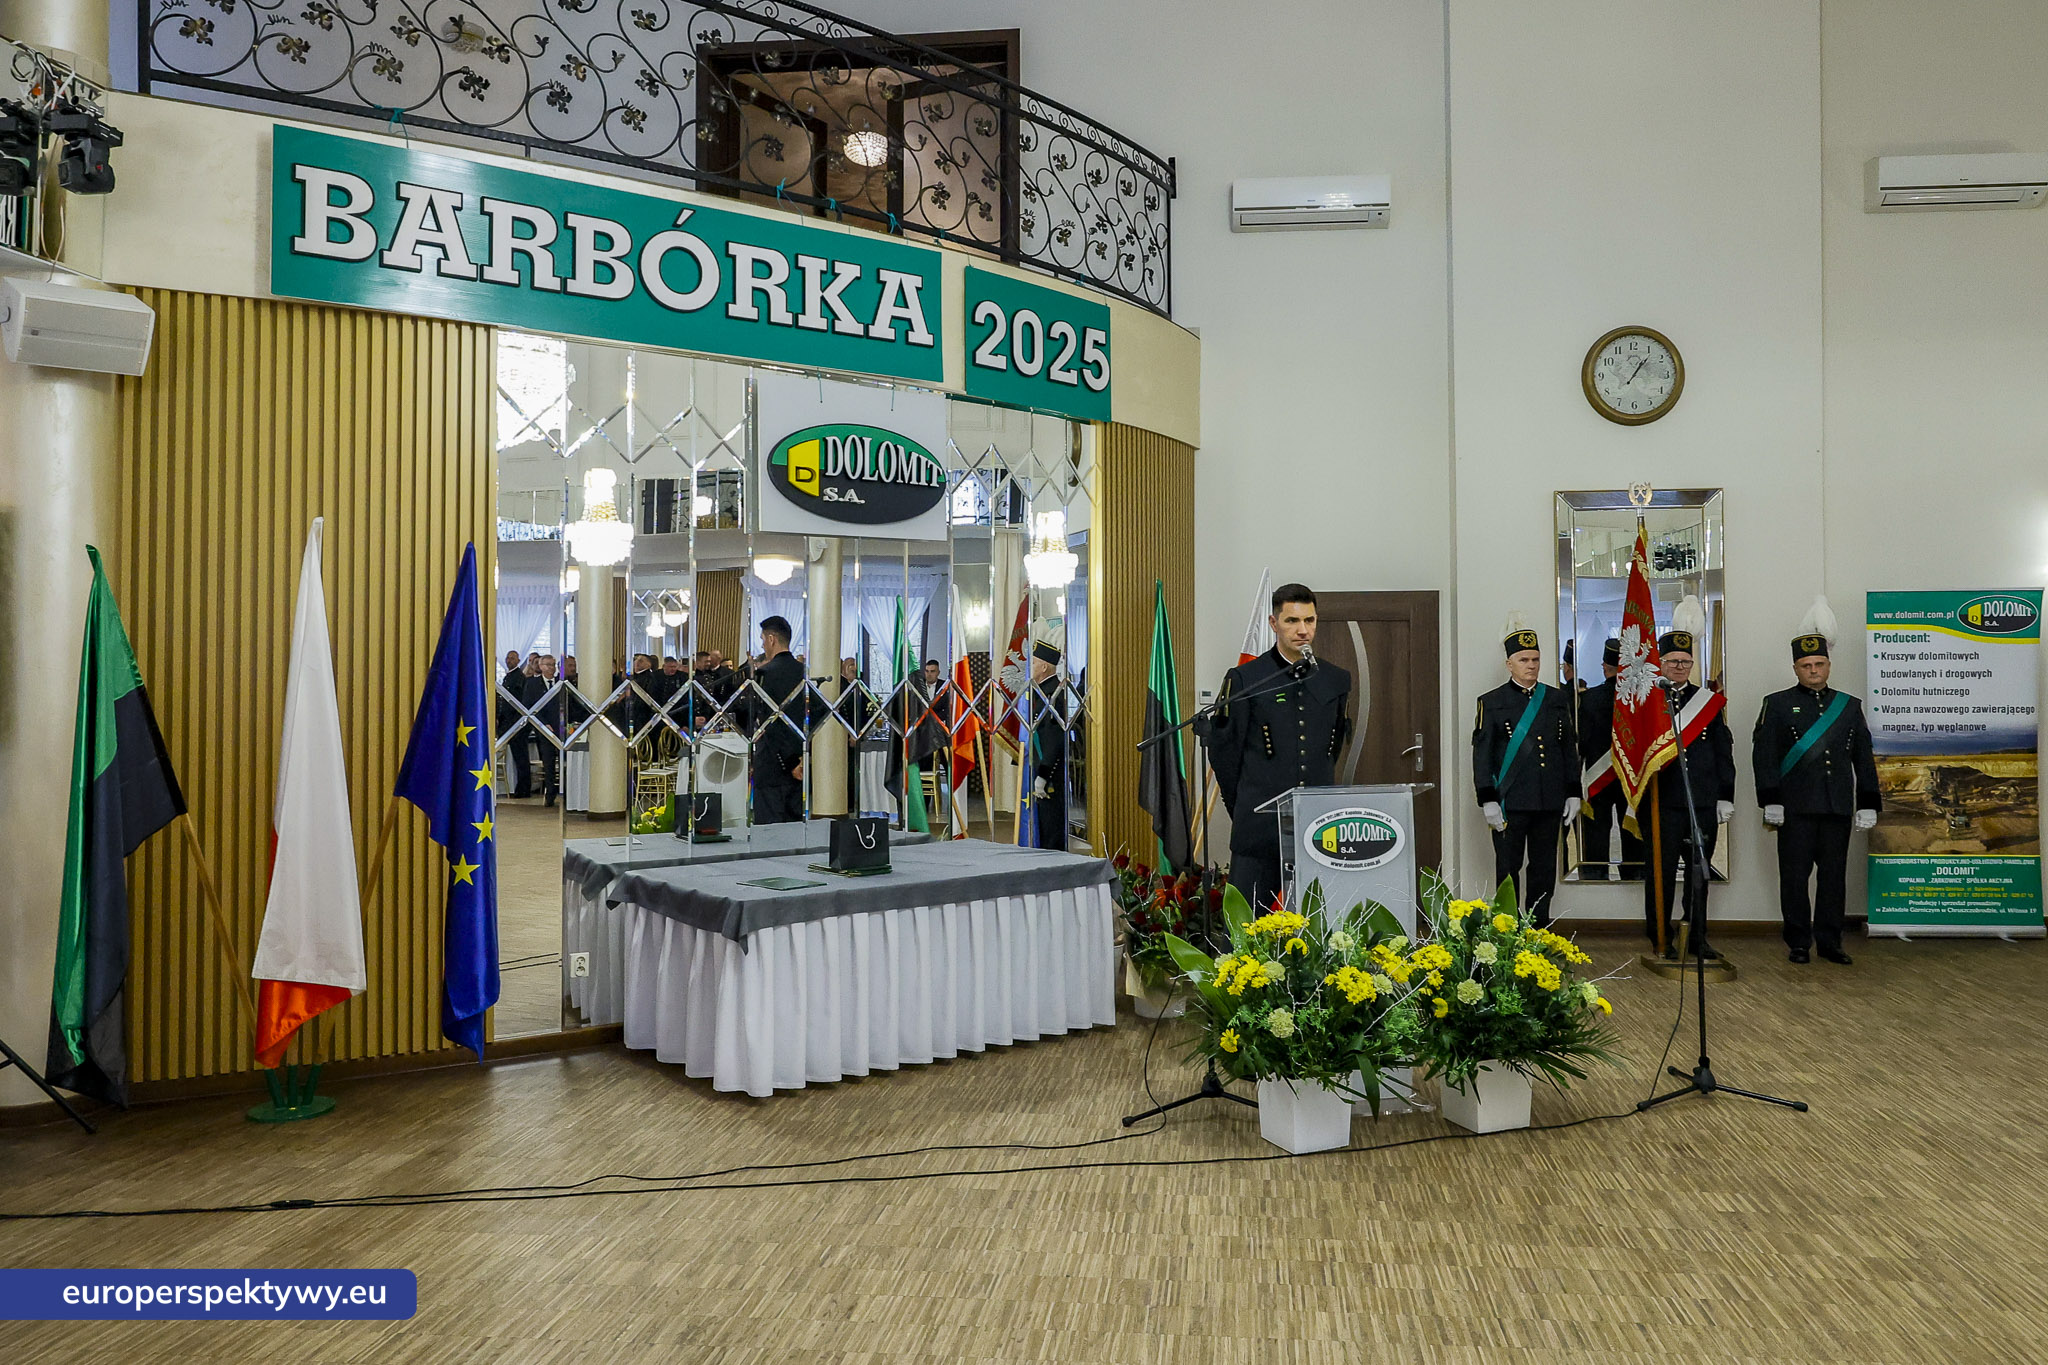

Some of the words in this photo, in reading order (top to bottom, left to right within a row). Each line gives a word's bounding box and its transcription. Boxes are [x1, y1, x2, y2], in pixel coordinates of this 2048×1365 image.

[291, 162, 935, 348] BARBÓRKA
[972, 299, 1111, 393] 2025
[1614, 346, 1622, 354] 11
[1629, 342, 1638, 350] 12
[1647, 346, 1651, 354] 1
[1603, 357, 1614, 366] 10
[1658, 354, 1664, 363] 2
[1598, 372, 1604, 381] 9
[1664, 370, 1670, 379] 3
[1604, 387, 1610, 395] 8
[1657, 386, 1663, 394] 4
[1617, 397, 1622, 407] 7
[1631, 401, 1638, 409] 6
[824, 434, 943, 488] DOLOMIT
[795, 466, 817, 483] D
[823, 487, 866, 504] S.A.
[1983, 600, 2032, 618] DOLOMIT
[1874, 610, 1954, 620] www.dolomit.com.pl
[1874, 632, 1931, 643] Producent:
[1881, 652, 1916, 662] Kruszyw
[1918, 651, 1980, 662] dolomitowych
[1881, 669, 1937, 679] budowlanych
[1939, 669, 1943, 678] i
[1945, 669, 1992, 679] drogowych
[1881, 687, 1920, 696] Dolomitu
[1922, 687, 1970, 697] hutniczego
[1881, 705, 1911, 715] Wapna
[1913, 706, 1970, 715] nawozowego
[1971, 705, 2036, 715] zawierającego
[1882, 724, 1919, 733] magnez,
[1921, 723, 1935, 732] typ
[1937, 722, 1987, 732] węglanowe
[1339, 822, 1392, 842] DOLOMIT
[1326, 840, 1334, 849] D
